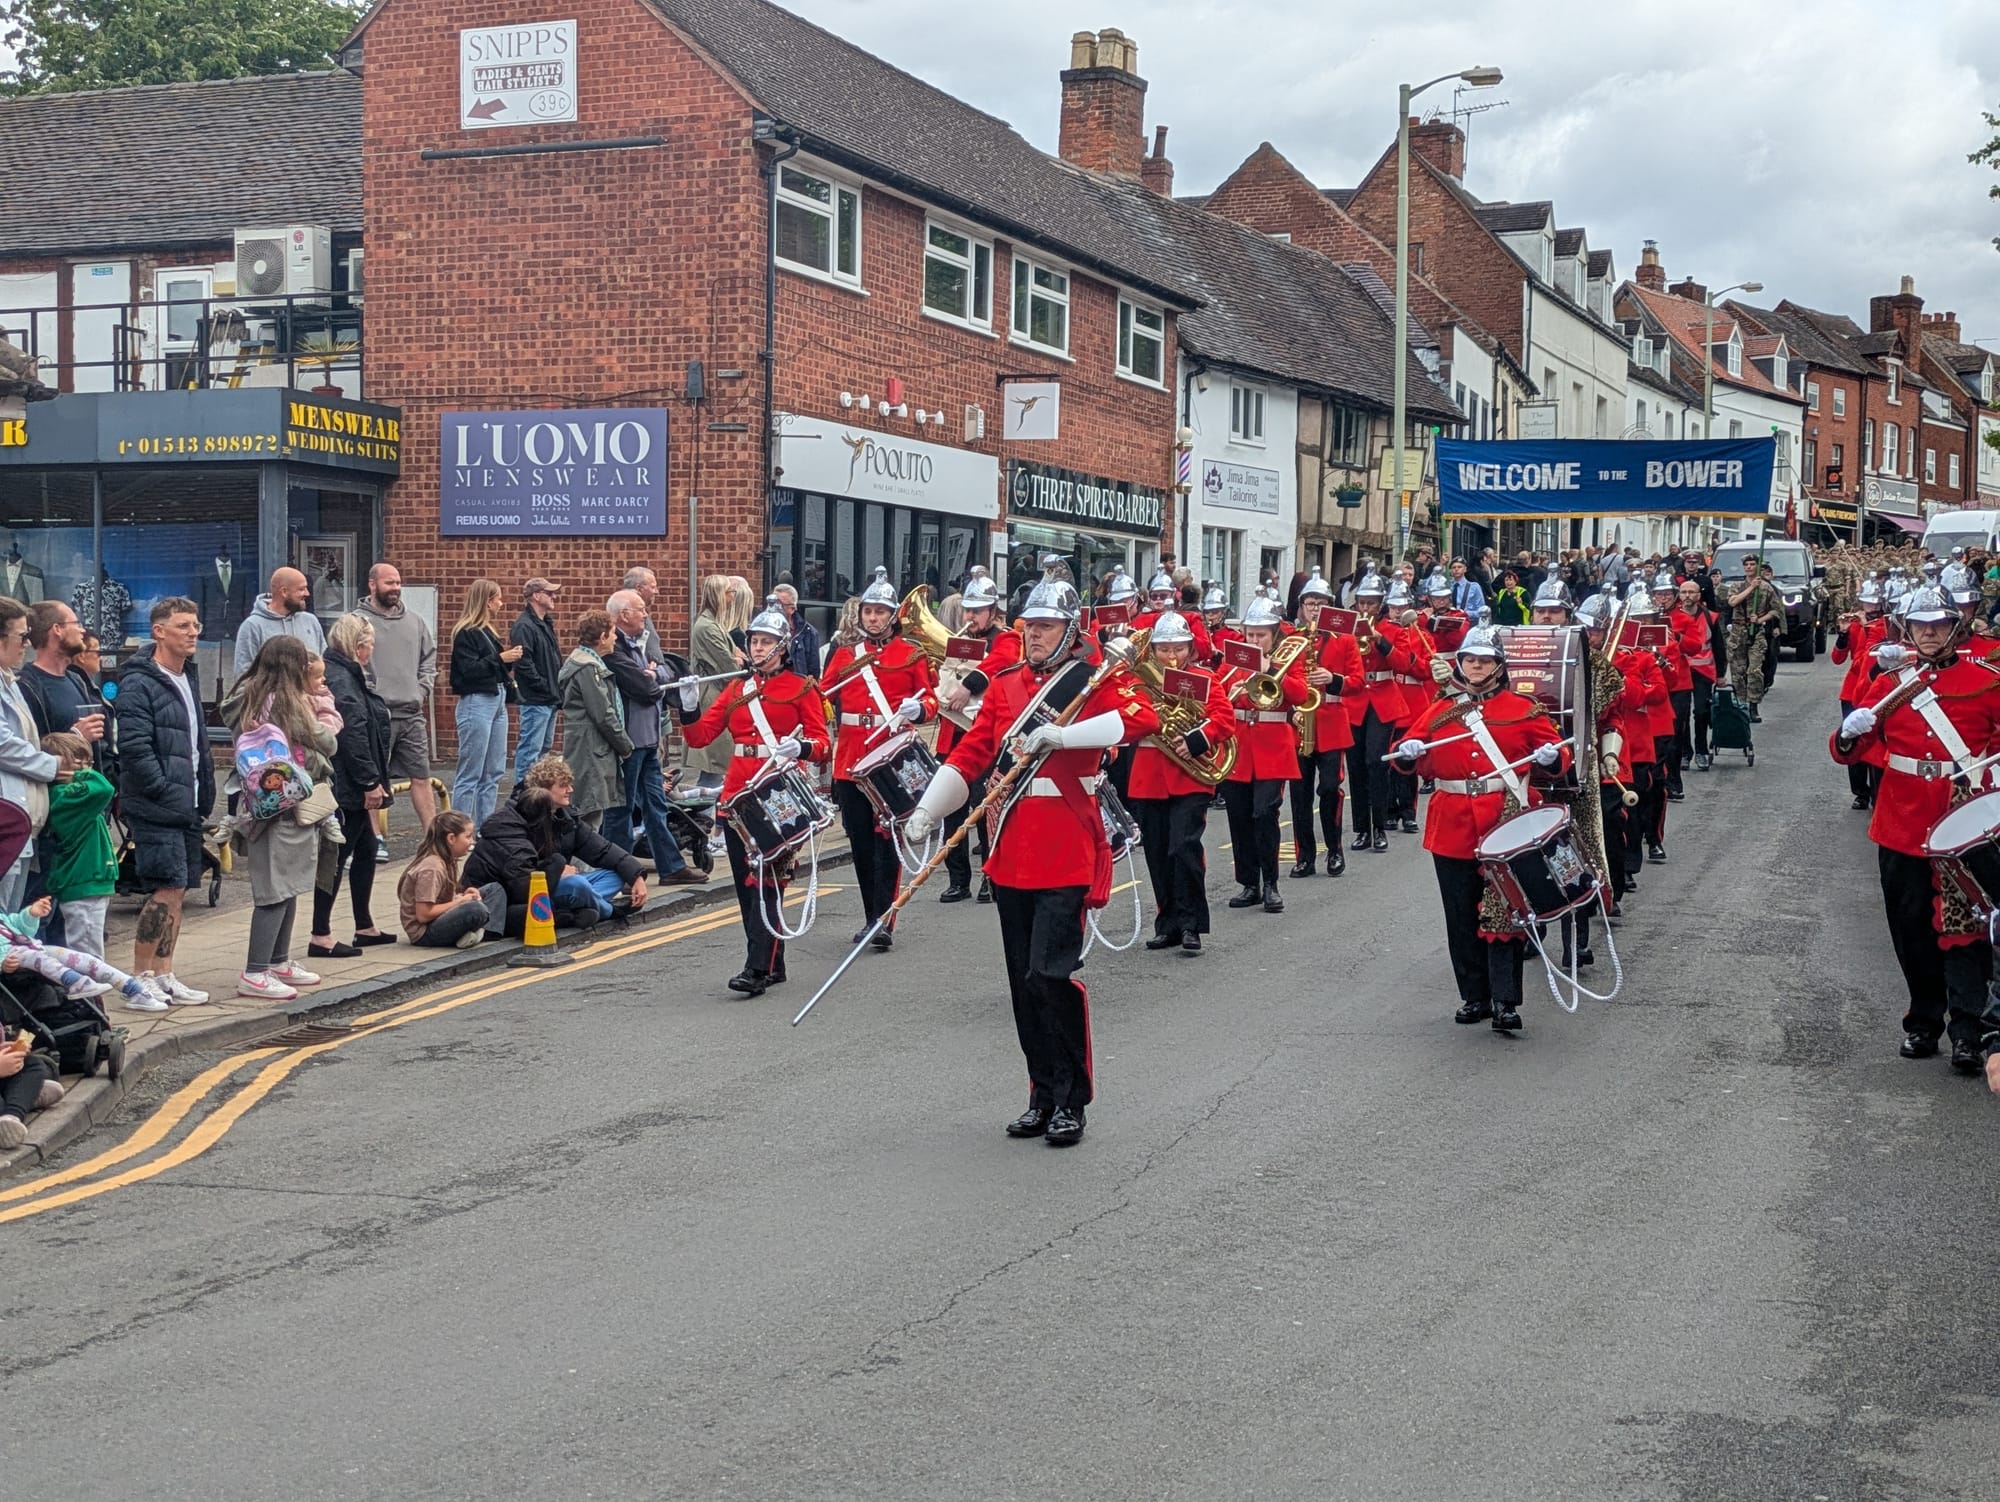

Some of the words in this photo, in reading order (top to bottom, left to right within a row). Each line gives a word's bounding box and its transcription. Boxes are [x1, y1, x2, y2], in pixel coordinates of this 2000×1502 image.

[468, 27, 568, 61] SNIPPS
[475, 67, 512, 80] LADIES
[516, 66, 522, 77] &
[527, 64, 562, 76] GENTS
[477, 79, 503, 91] HAIR
[507, 75, 560, 88] STYLIST'S
[289, 401, 399, 442] MENSWEAR
[138, 436, 199, 455] 01543
[204, 434, 277, 453] 898972
[287, 430, 354, 456] WEDDING
[356, 442, 398, 461] SUITS
[865, 443, 933, 483] POQUITO
[455, 467, 651, 488] MENSWEAR
[1458, 462, 1581, 491] WELCOME
[1598, 470, 1609, 481] TO
[1611, 470, 1628, 481] THE
[1645, 460, 1743, 488] BOWER
[531, 494, 571, 507] BOSS
[582, 497, 611, 507] MARC
[615, 496, 649, 507] DARCY
[1031, 474, 1074, 514] THREE
[1075, 483, 1115, 521] SPIRES
[1116, 491, 1160, 528] BARBER
[1228, 487, 1258, 507] Tailoring
[456, 515, 488, 525] REMUS
[490, 515, 520, 525] UOMO
[581, 515, 649, 525] TRESANTI
